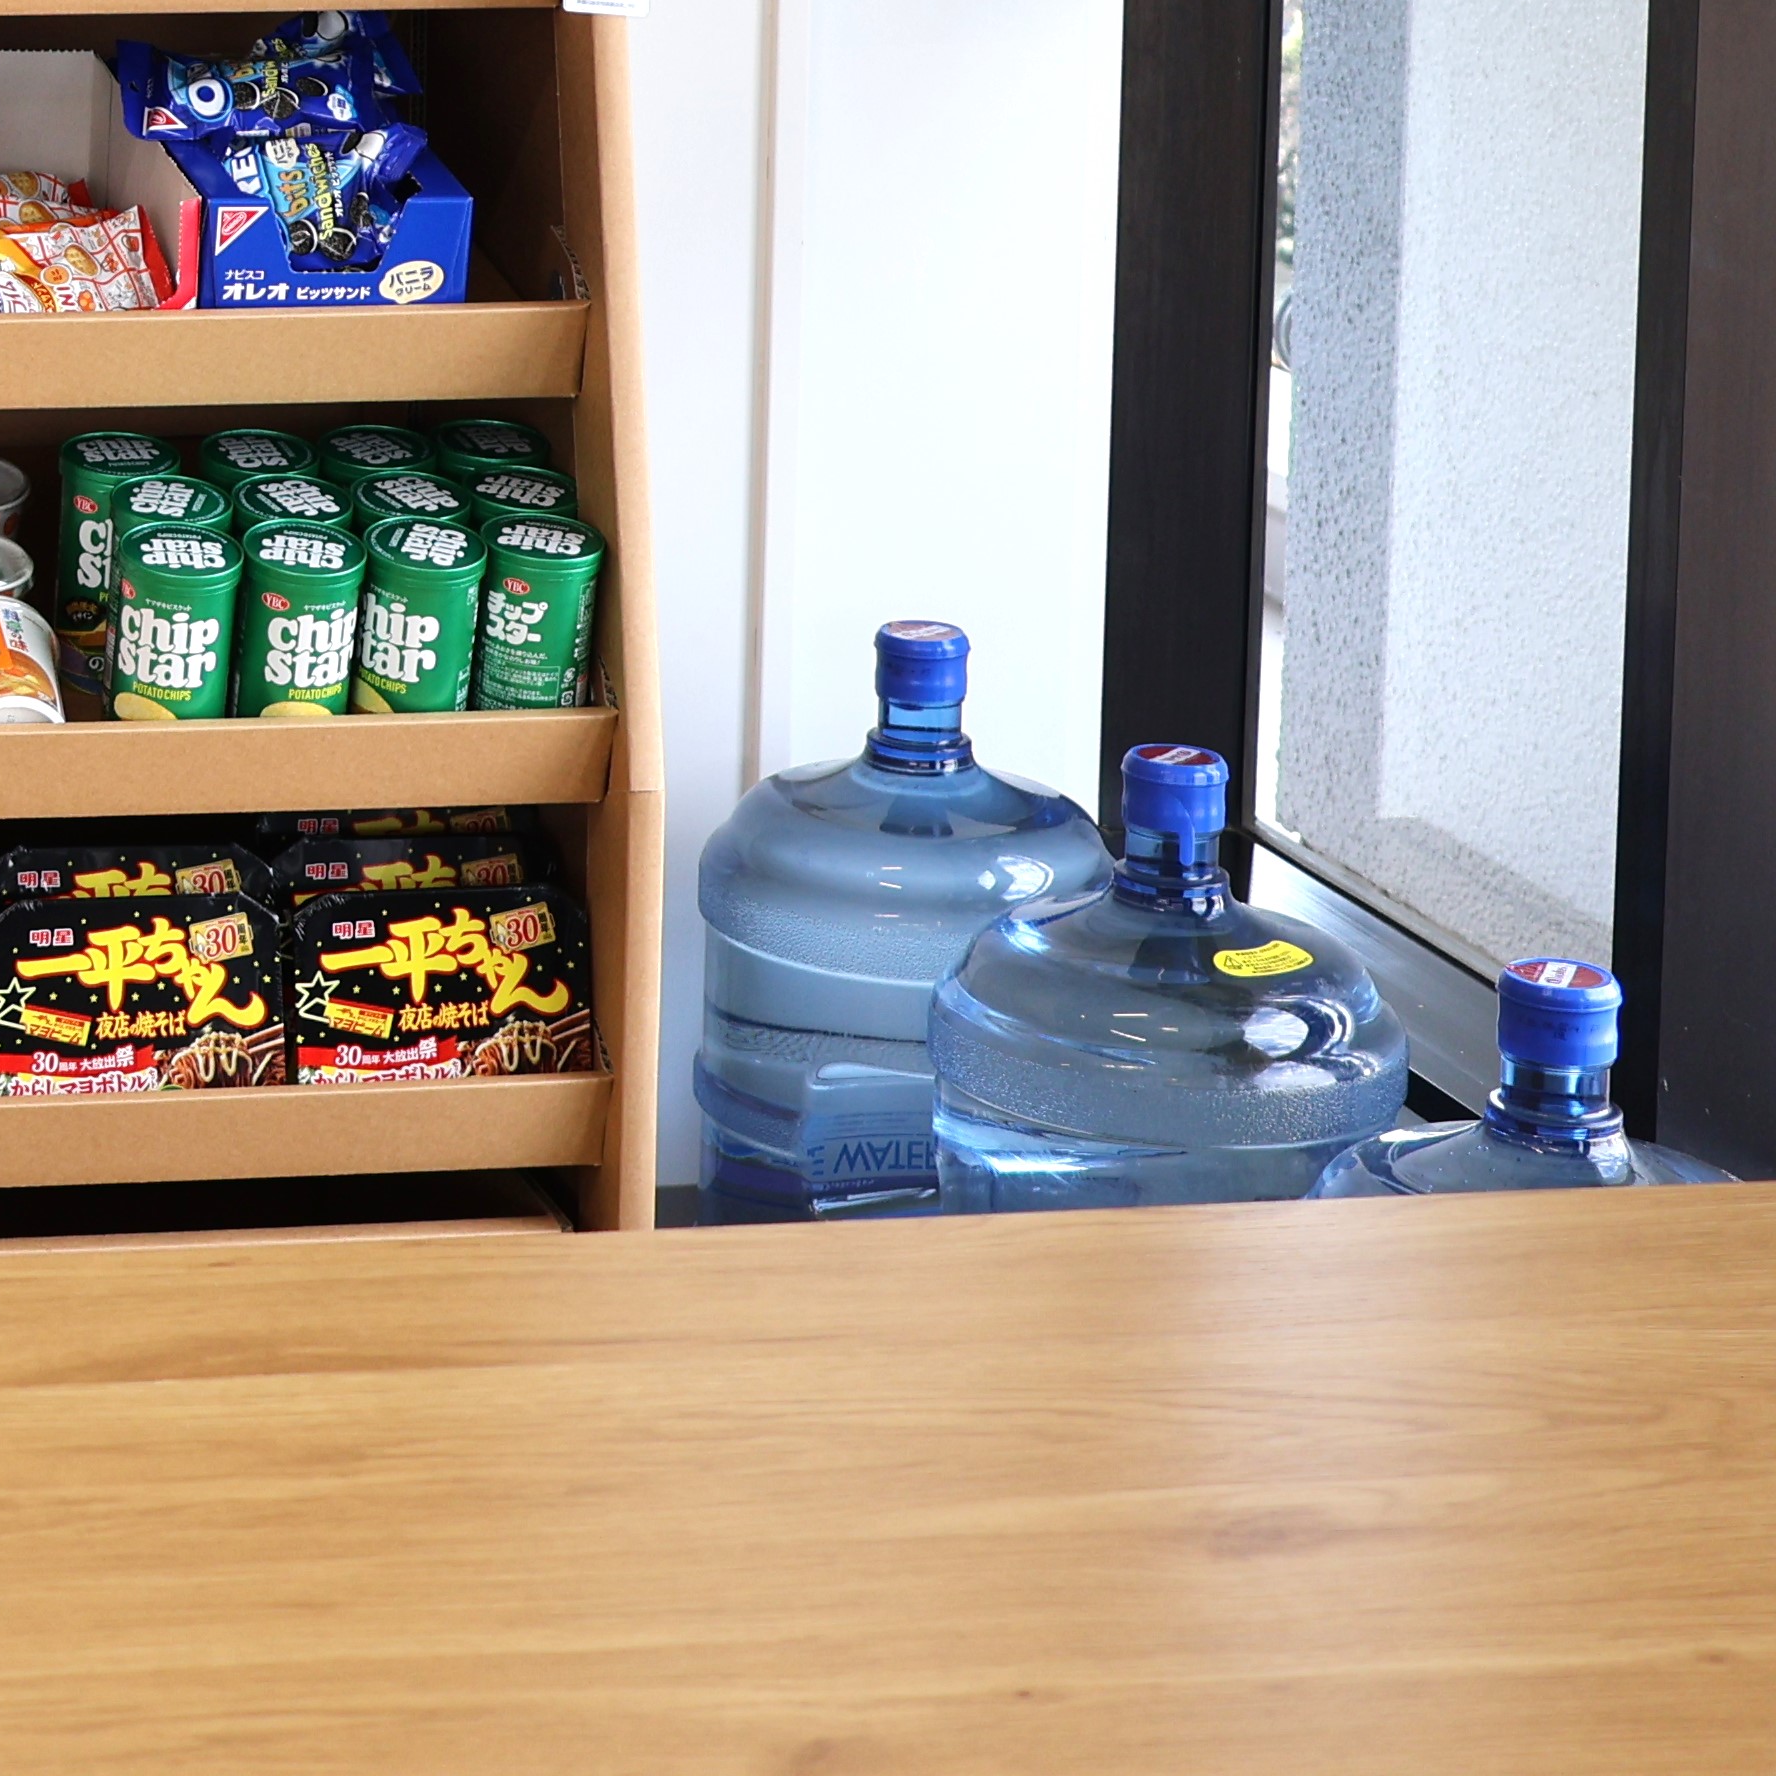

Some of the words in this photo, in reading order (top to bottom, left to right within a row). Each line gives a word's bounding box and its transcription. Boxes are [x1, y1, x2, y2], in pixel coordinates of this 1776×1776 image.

[390, 268, 434, 287] バニラ
[223, 283, 290, 300] オレオ
[296, 286, 371, 299] ビッツサンド
[503, 578, 530, 595] YBC
[262, 593, 290, 610] YBC
[488, 591, 548, 624] チップ
[486, 614, 541, 644] スター
[132, 682, 164, 698] POTATO
[164, 689, 191, 700] CHIPS
[288, 686, 320, 699] POTATO
[320, 684, 341, 697] CHIPS
[28, 928, 74, 947] 明星
[332, 920, 376, 939] 明星
[16, 915, 266, 1026] 一平ちゃん
[320, 907, 569, 1014] 一平ちゃん
[95, 1011, 187, 1038] 夜店の焼そば
[398, 1005, 491, 1032] 夜店の焼そば
[31, 1049, 78, 1073] 30周年
[80, 1043, 136, 1072] 大放出祭
[335, 1043, 381, 1066] 30周年
[382, 1036, 438, 1064] 大放出祭
